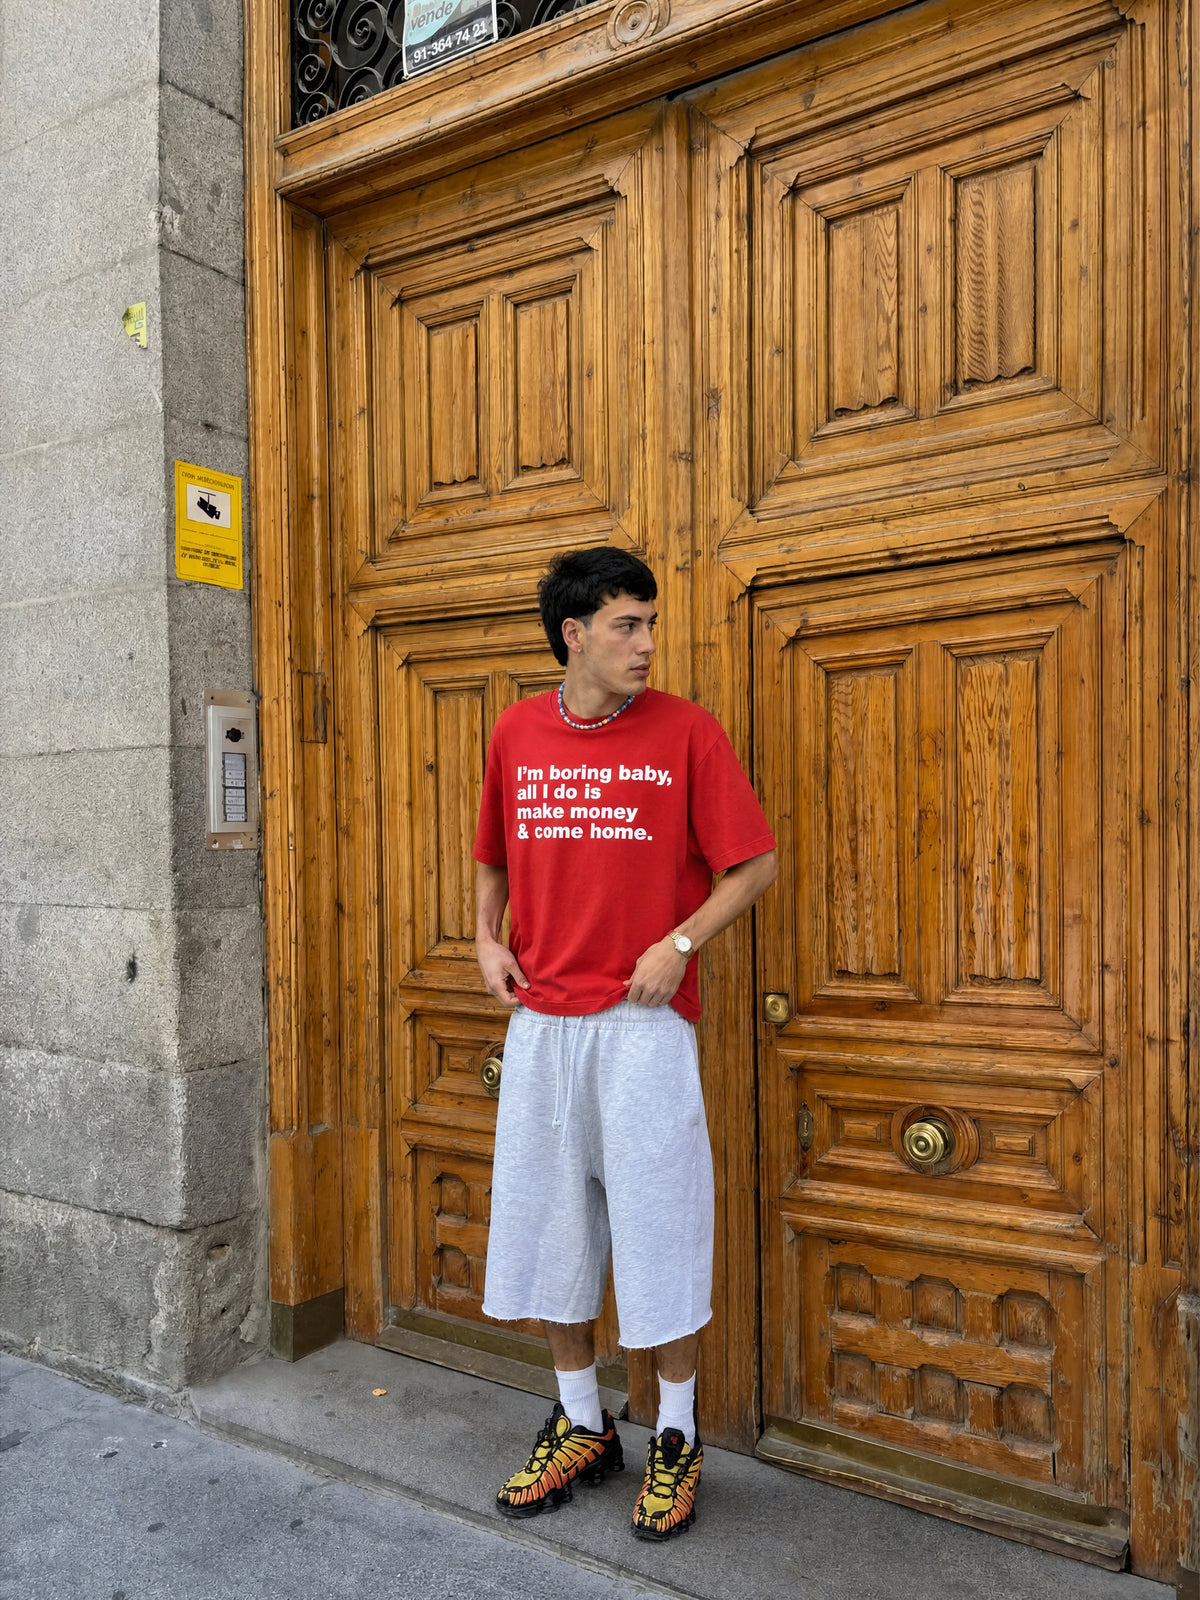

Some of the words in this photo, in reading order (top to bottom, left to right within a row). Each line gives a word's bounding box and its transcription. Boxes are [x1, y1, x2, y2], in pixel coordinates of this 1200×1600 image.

[411, 1, 453, 31] vende
[413, 38, 453, 63] 91-364
[456, 29, 471, 45] 74
[472, 20, 488, 38] 21
[517, 765, 544, 782] I'm
[549, 764, 612, 784] boring
[618, 764, 673, 787] baby,
[517, 783, 537, 800] all
[542, 783, 548, 799] I
[553, 783, 578, 800] do
[584, 783, 602, 800] is
[517, 802, 565, 820] make
[570, 806, 639, 823] money
[517, 822, 529, 840] &
[534, 825, 584, 840] come
[590, 822, 653, 841] home.
